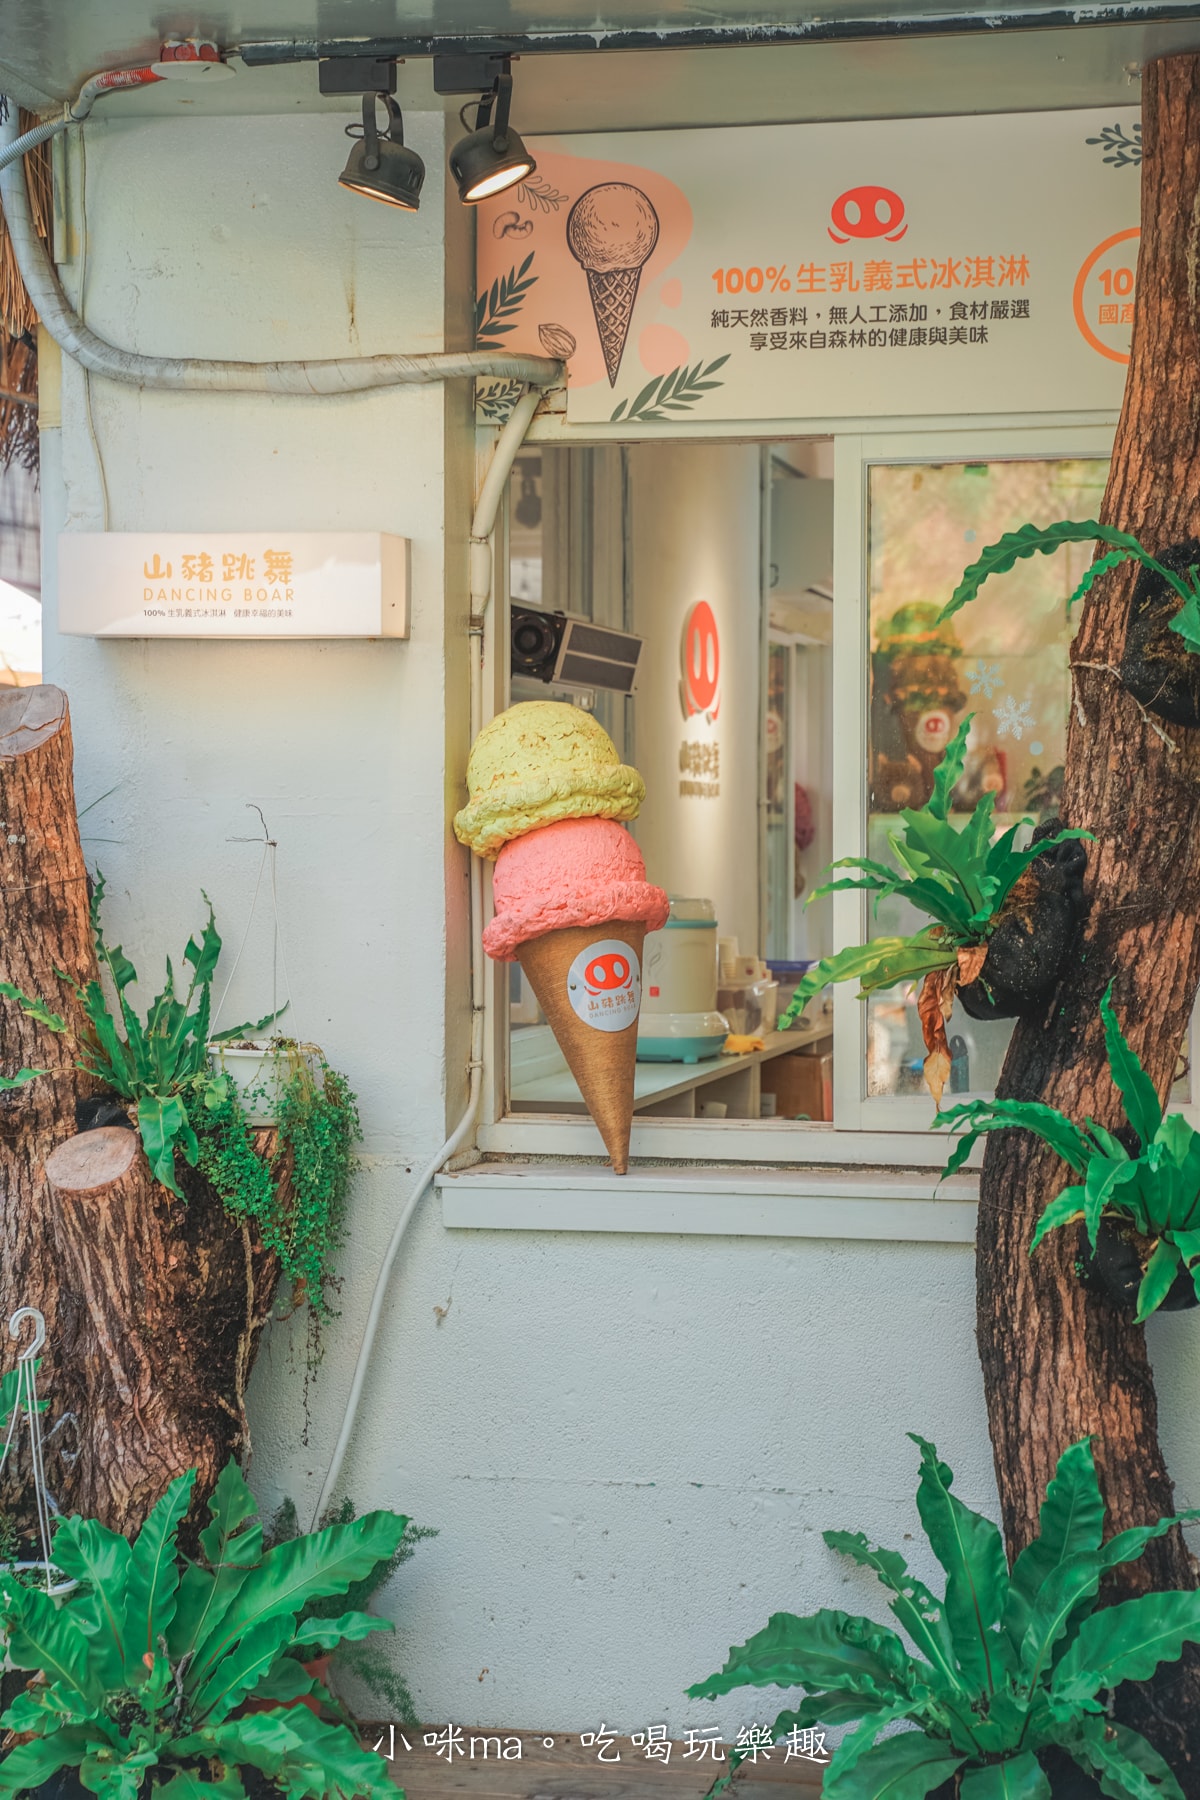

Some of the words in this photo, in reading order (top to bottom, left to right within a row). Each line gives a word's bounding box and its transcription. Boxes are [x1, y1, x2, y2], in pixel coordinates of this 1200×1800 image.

[749, 325, 989, 352] 享受來自森林的健康與美味
[143, 549, 294, 585] 山豬跳舞
[143, 588, 233, 602] DANCING
[243, 588, 295, 602] BOAR
